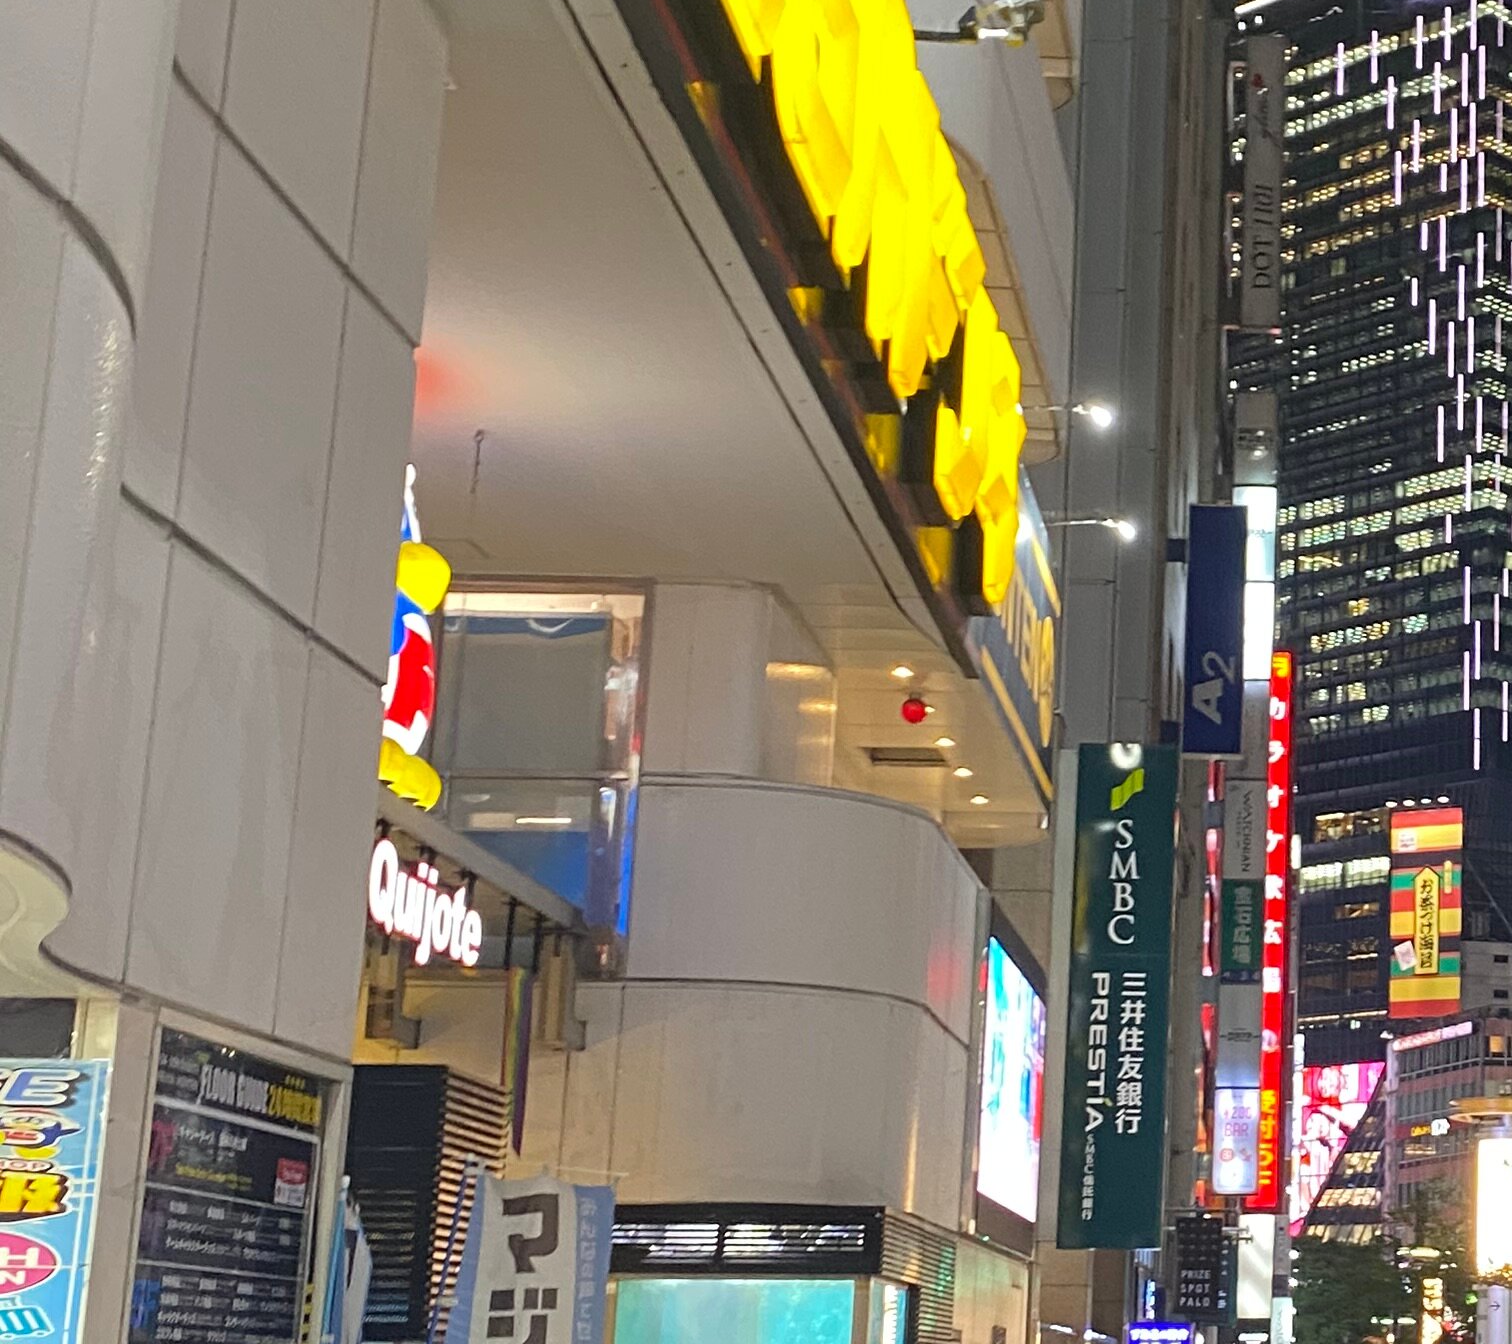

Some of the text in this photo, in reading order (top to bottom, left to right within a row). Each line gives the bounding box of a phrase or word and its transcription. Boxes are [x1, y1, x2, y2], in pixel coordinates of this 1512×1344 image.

[1192, 650, 1236, 726] A2
[368, 839, 482, 966] Quijote
[1108, 818, 1141, 945] SMBC
[1114, 972, 1148, 1135] 三井住友銀行
